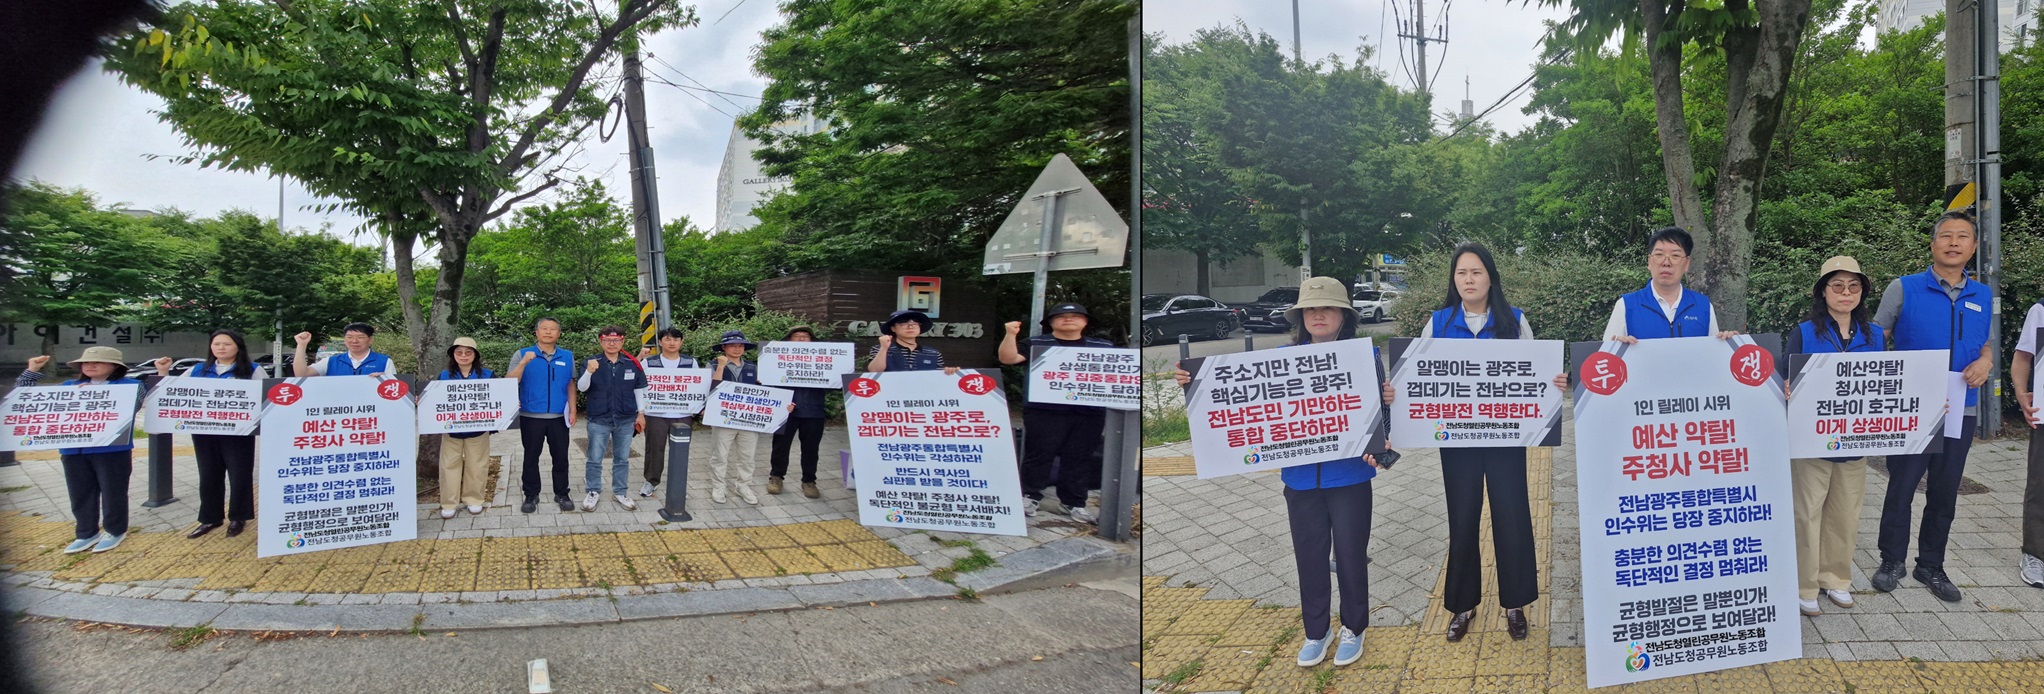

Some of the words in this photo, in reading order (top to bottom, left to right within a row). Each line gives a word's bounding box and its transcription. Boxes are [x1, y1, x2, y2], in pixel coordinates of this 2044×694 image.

[948, 322, 983, 338] 303
[1076, 353, 1134, 363] 전남광주
[778, 362, 812, 370] 인수위는
[815, 363, 833, 371] 당장
[1215, 359, 1290, 385] 주소지만
[1296, 352, 1338, 374] 전남!
[1417, 360, 1481, 376] 알맹이는
[1486, 361, 1536, 377] 광주로,
[1592, 359, 1616, 389] 투
[1739, 351, 1761, 380] 쟁
[1837, 360, 1904, 377] 예산약탈!
[1043, 371, 1070, 380] 광주
[166, 387, 210, 397] 알맹이는
[214, 389, 248, 399] 광주로,
[276, 387, 294, 402] 투
[384, 382, 399, 397] 쟁
[447, 383, 490, 392] 예산약탈!
[734, 386, 770, 397] 통합인가!
[856, 381, 873, 395] 투
[967, 377, 984, 393] 쟁
[1050, 382, 1106, 393] 인수위는
[1211, 379, 1305, 406] 핵심기능은
[1311, 372, 1353, 393] 광주!
[1407, 382, 1471, 398] 껍데기는
[1476, 382, 1547, 398] 전남으로?
[1835, 380, 1903, 397] 청사약탈!
[18, 391, 75, 402] 주소지만
[78, 390, 110, 400] 전남!
[158, 398, 202, 408] 껍데기는
[206, 400, 256, 410] 전남으로?
[448, 393, 490, 402] 청사약탈!
[719, 392, 743, 402] 전남만
[746, 396, 782, 407] 희생인가!
[886, 400, 900, 408] 1인
[903, 399, 935, 408] 릴레이
[938, 399, 960, 408] 시위
[12, 402, 80, 412] 핵심기능은
[85, 401, 117, 410] 광주!
[306, 408, 320, 416] 1인
[323, 406, 353, 415] 릴레이
[356, 405, 375, 413] 시위
[436, 403, 465, 412] 전남이
[469, 402, 502, 410] 호구냐!
[721, 401, 754, 412] 핵심부서
[1208, 403, 1283, 429] 전남도민
[1288, 393, 1362, 418] 기만하는
[1409, 403, 1473, 420] 균형발전
[1478, 403, 1543, 419] 역행한다.
[1634, 400, 1653, 416] 1인
[1658, 398, 1699, 415] 릴레이
[1704, 395, 1731, 411] 시위
[1817, 399, 1863, 416] 전남이
[1869, 397, 1919, 414] 호구냐!
[4, 414, 59, 425] 전남도민
[64, 411, 119, 422] 기만하는
[158, 409, 203, 419] 균형발전
[207, 411, 252, 421] 역행한다.
[436, 413, 456, 421] 이게
[460, 411, 502, 420] 상생이냐!
[861, 411, 926, 424] 알맹이는
[932, 411, 991, 424] 광주로,
[13, 425, 41, 436] 통합
[46, 423, 105, 434] 중단하라!
[303, 419, 336, 433] 예산
[341, 417, 378, 430] 약탈!
[858, 426, 919, 438] 껍데기는
[924, 425, 1001, 439] 전남으로?
[1227, 427, 1265, 448] 통합
[1270, 415, 1349, 442] 중단하라!
[1816, 419, 1846, 435] 이게
[1852, 416, 1918, 433] 상생이냐!
[294, 434, 344, 449] 주청사
[350, 432, 386, 444] 약탈!
[1451, 432, 1520, 440] 전남도청공무원노동조합
[1632, 423, 1678, 450] 예산
[1685, 419, 1736, 446] 약탈!
[877, 443, 983, 453] 전남광주통합특별시
[1262, 445, 1339, 462] 전남도청공무원노동조합
[289, 451, 390, 466] 전남광주통합특별시
[881, 453, 926, 462] 인수위는
[930, 453, 982, 463] 각성하라!
[1623, 452, 1692, 481] 주청사
[1698, 448, 1749, 474] 약탈!
[278, 467, 324, 478] 인수위는
[328, 463, 350, 474] 당장
[353, 460, 400, 472] 중지하라!
[896, 468, 930, 477] 반드시
[934, 468, 970, 478] 역사의
[283, 483, 318, 494] 충분한
[322, 478, 366, 491] 의견수렴
[370, 476, 391, 485] 없는
[883, 476, 916, 486] 심판을
[920, 478, 943, 487] 받을
[947, 479, 988, 489] 것이다!
[283, 493, 329, 504] 독단적인
[333, 489, 355, 500] 결정
[359, 486, 395, 497] 멈춰라!
[876, 491, 898, 499] 예산
[901, 492, 928, 501] 약탈!
[931, 492, 968, 503] 주청사
[971, 494, 1000, 505] 약탈!
[1619, 485, 1757, 514] 전남광주통합특별시
[346, 502, 394, 516] 말뿐인가!
[869, 499, 914, 510] 독단적인
[917, 502, 953, 512] 불균형
[957, 504, 1011, 515] 부서배치!
[279, 517, 348, 533] 균형행정으로
[352, 512, 399, 525] 보여달라!
[1605, 515, 1668, 536] 인수위는
[1673, 510, 1704, 529] 당장
[1708, 504, 1772, 526] 중지하라!
[307, 529, 391, 545] 전남도청공무원노동조합
[1615, 546, 1662, 567] 충분한
[1667, 539, 1728, 562] 의견수렴
[1733, 537, 1762, 555] 없는
[1616, 565, 1679, 588] 독단적인
[1684, 561, 1714, 581] 결정
[1719, 556, 1768, 577] 멈춰라!
[1620, 594, 1698, 620] 균형발절은
[1703, 586, 1767, 611] 말뿐인가!
[1613, 615, 1706, 643] 균형행정으로
[1712, 606, 1776, 630] 보여달라!
[1645, 627, 1766, 653] 전남도청열린공무원노동조합
[1653, 640, 1768, 667] 전남도청공무원노동조합
